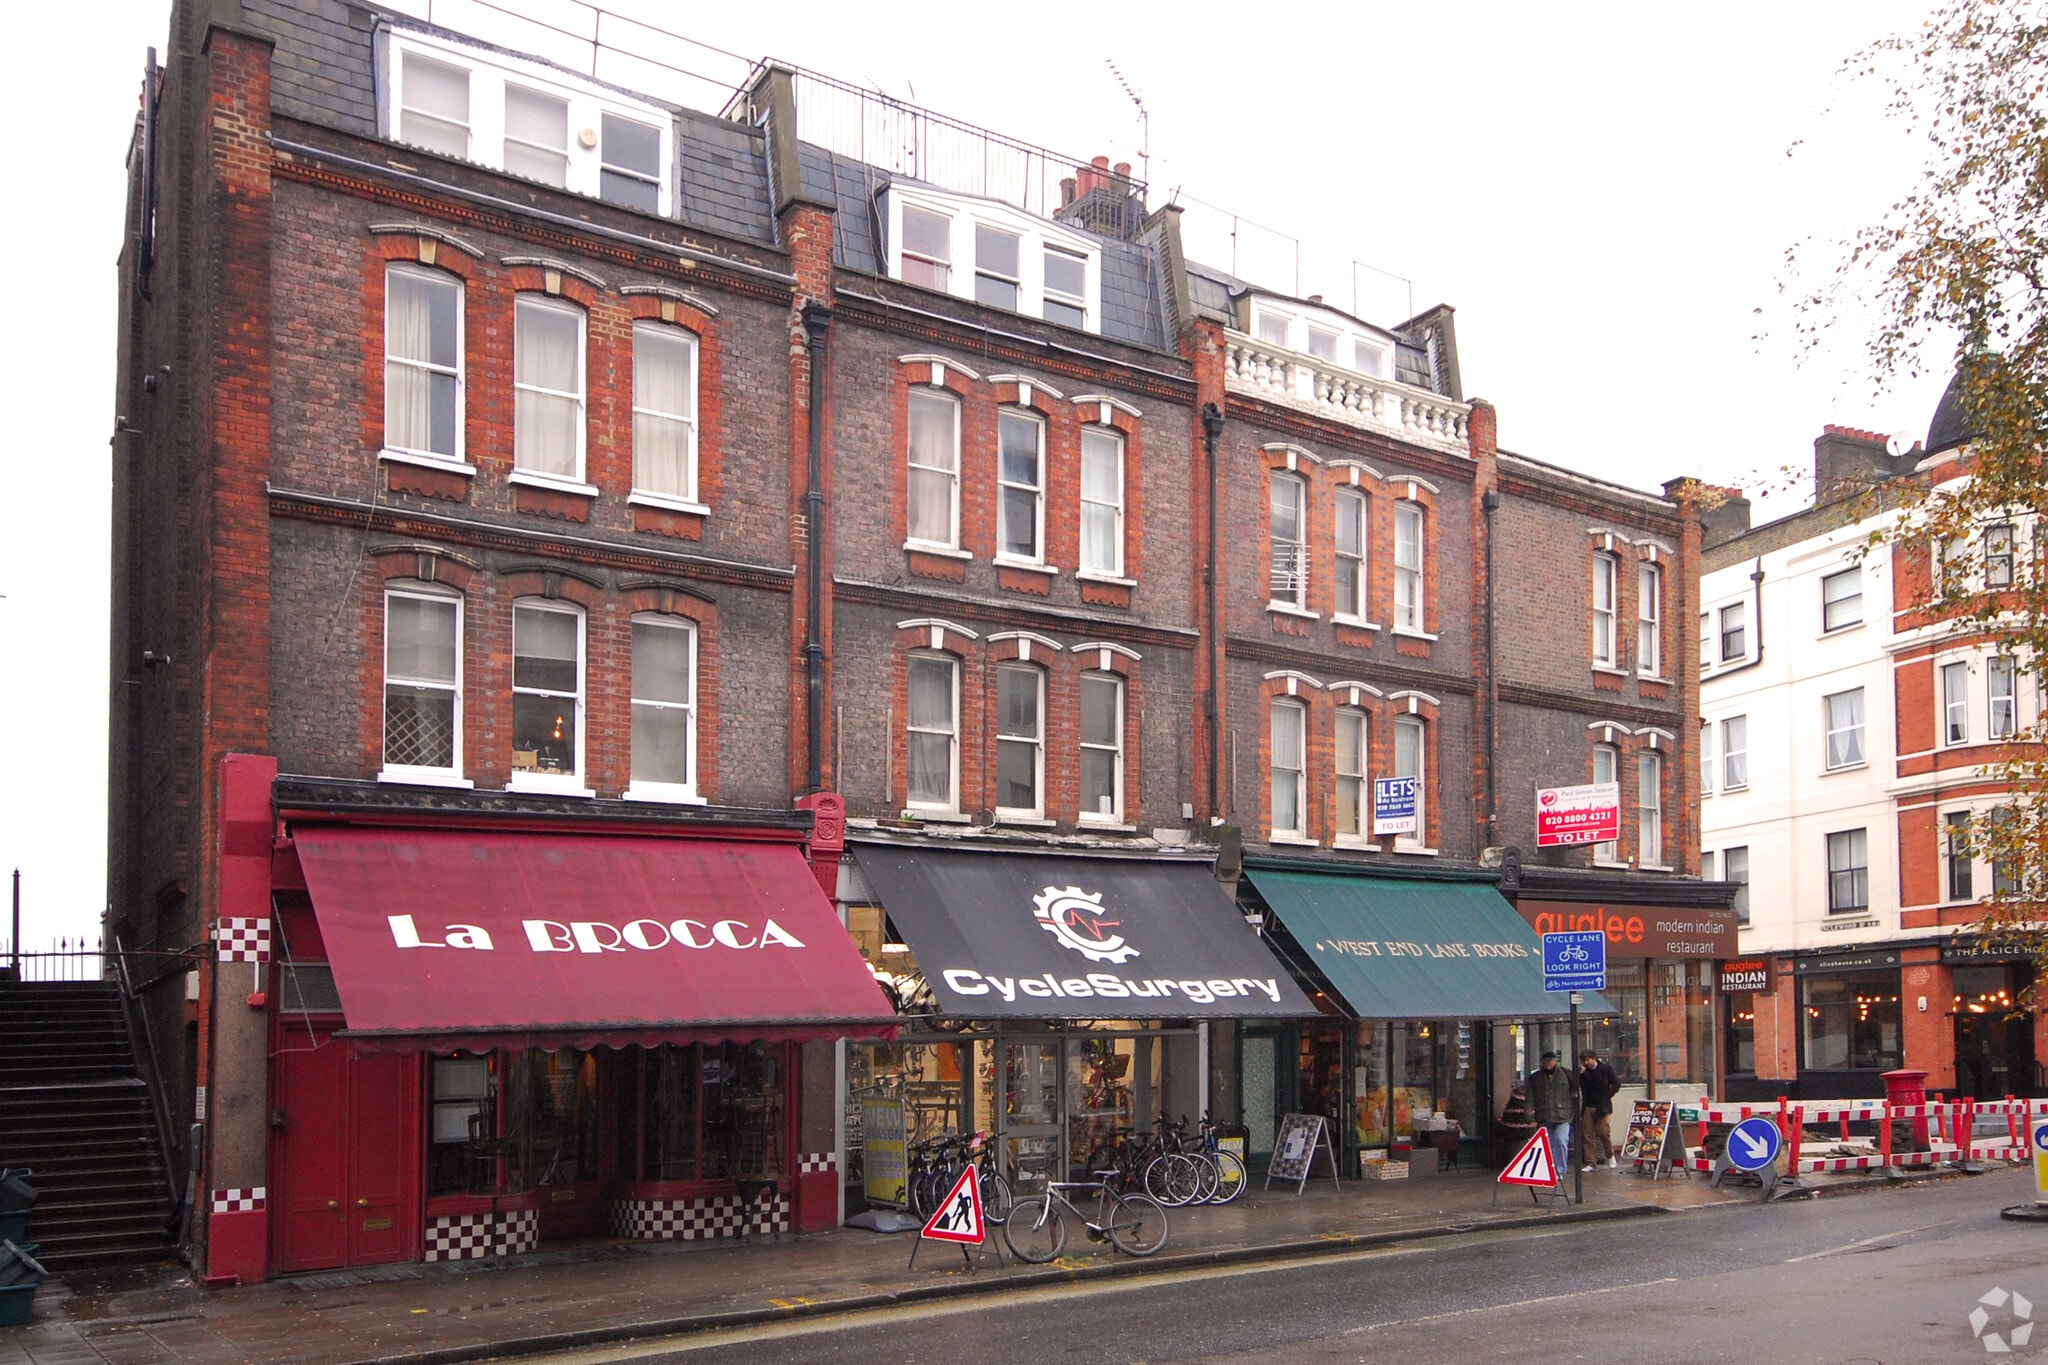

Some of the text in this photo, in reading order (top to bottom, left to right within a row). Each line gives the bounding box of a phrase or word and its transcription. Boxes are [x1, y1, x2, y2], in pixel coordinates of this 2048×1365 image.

[1382, 780, 1414, 797] LETS
[1545, 811, 1611, 825] 020 8800 4321
[1396, 821, 1410, 829] LET
[1556, 831, 1599, 843] TO LET
[1656, 918, 1725, 935] modern indian
[388, 914, 806, 953] La BROCCA
[1546, 934, 1601, 943] CYCLE LANE
[1326, 940, 1528, 958] WEST END LANE BOOKS
[1666, 941, 1715, 954] restaurant
[1955, 948, 1978, 956] THE
[1982, 945, 2020, 955] ALICE
[1547, 962, 1601, 972] LOOK RIGHT
[1724, 961, 1764, 973] guglee
[1722, 971, 1766, 985] INDIAN
[943, 969, 1282, 1004] CycleSurgery
[1721, 983, 1766, 991] RESTAURANT
[866, 1107, 900, 1127] NEW
[866, 1129, 902, 1140] SEASON
[1220, 1141, 1242, 1150] NEW
